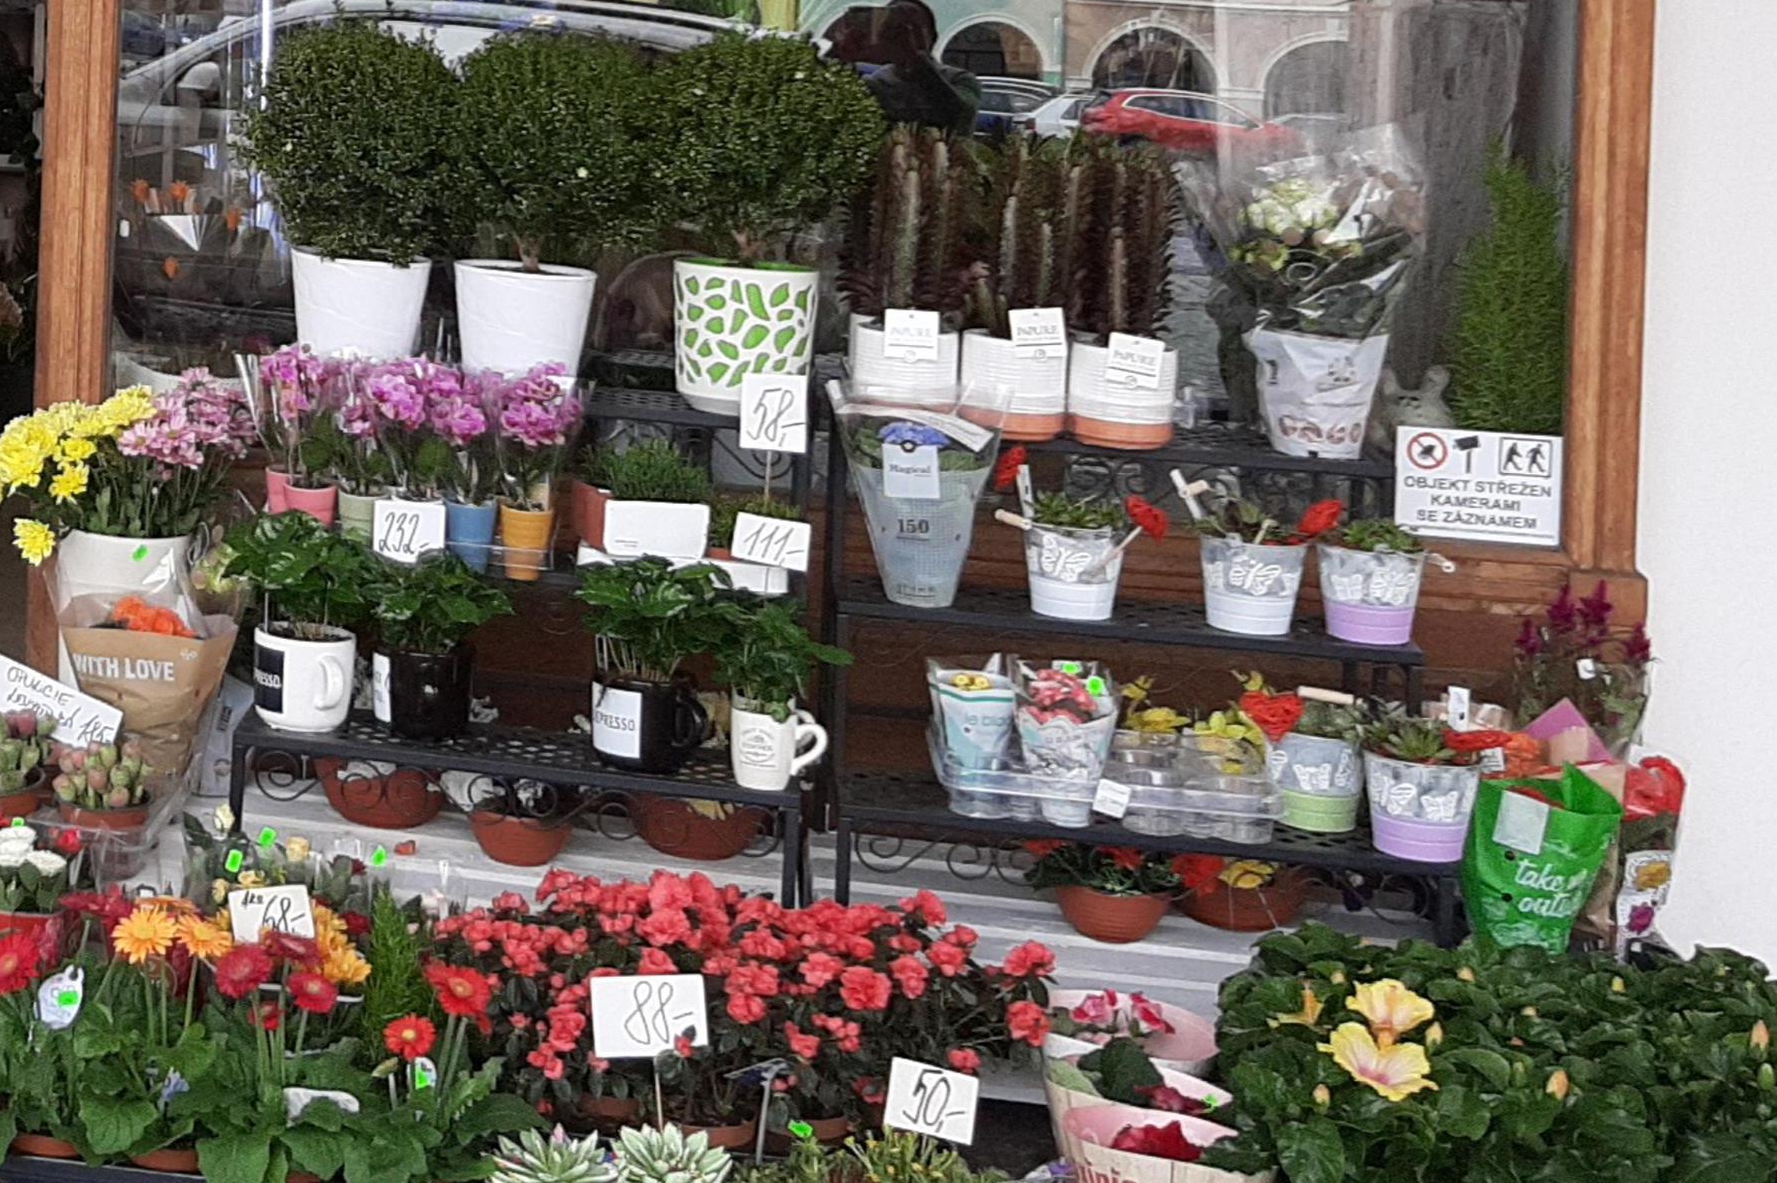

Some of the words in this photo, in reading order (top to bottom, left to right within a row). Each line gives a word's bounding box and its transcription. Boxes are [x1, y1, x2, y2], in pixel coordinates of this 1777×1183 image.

[1403, 475, 1471, 493] OBJEKT
[1474, 479, 1553, 498] STŘEŽEN
[1430, 493, 1521, 512] KAMERAMI
[896, 518, 930, 534] 150
[1416, 509, 1438, 523] SE
[1442, 509, 1538, 530] ZÁZNAMEM
[72, 653, 119, 678] WITH
[124, 657, 176, 682] LOVE
[1515, 858, 1565, 892] take
